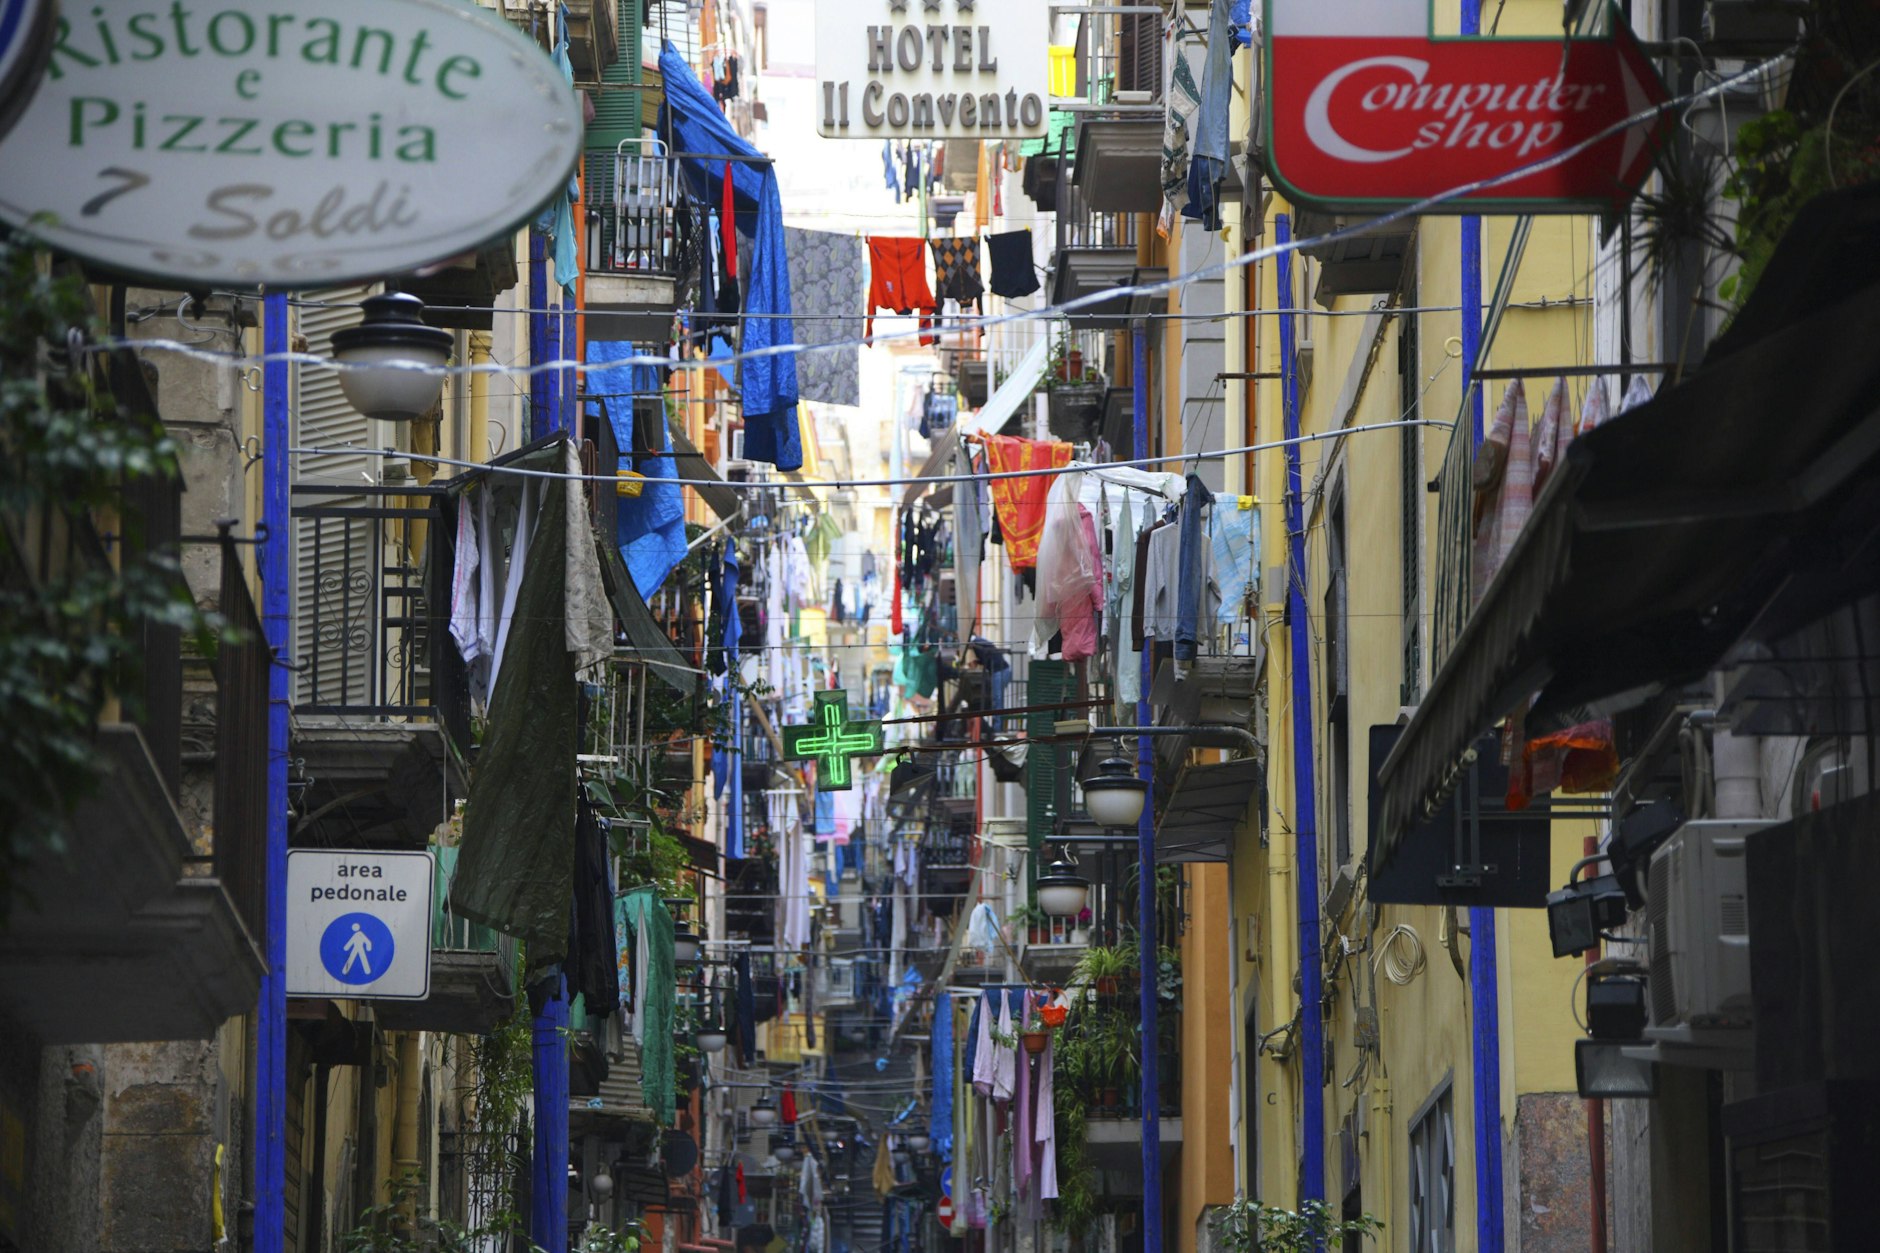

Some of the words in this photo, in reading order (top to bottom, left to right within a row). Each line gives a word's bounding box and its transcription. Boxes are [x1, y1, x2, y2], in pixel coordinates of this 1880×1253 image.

[866, 24, 997, 72] HOTEL
[236, 69, 261, 98] e
[822, 81, 849, 128] Il
[862, 80, 1043, 128] Convento
[69, 97, 438, 162] Pizzeria
[1304, 55, 1607, 163] Computer
[1413, 112, 1564, 158] shop
[81, 167, 150, 217] 7
[188, 180, 417, 241] Soldi
[310, 884, 407, 902] pedonale
[337, 864, 383, 878] area
